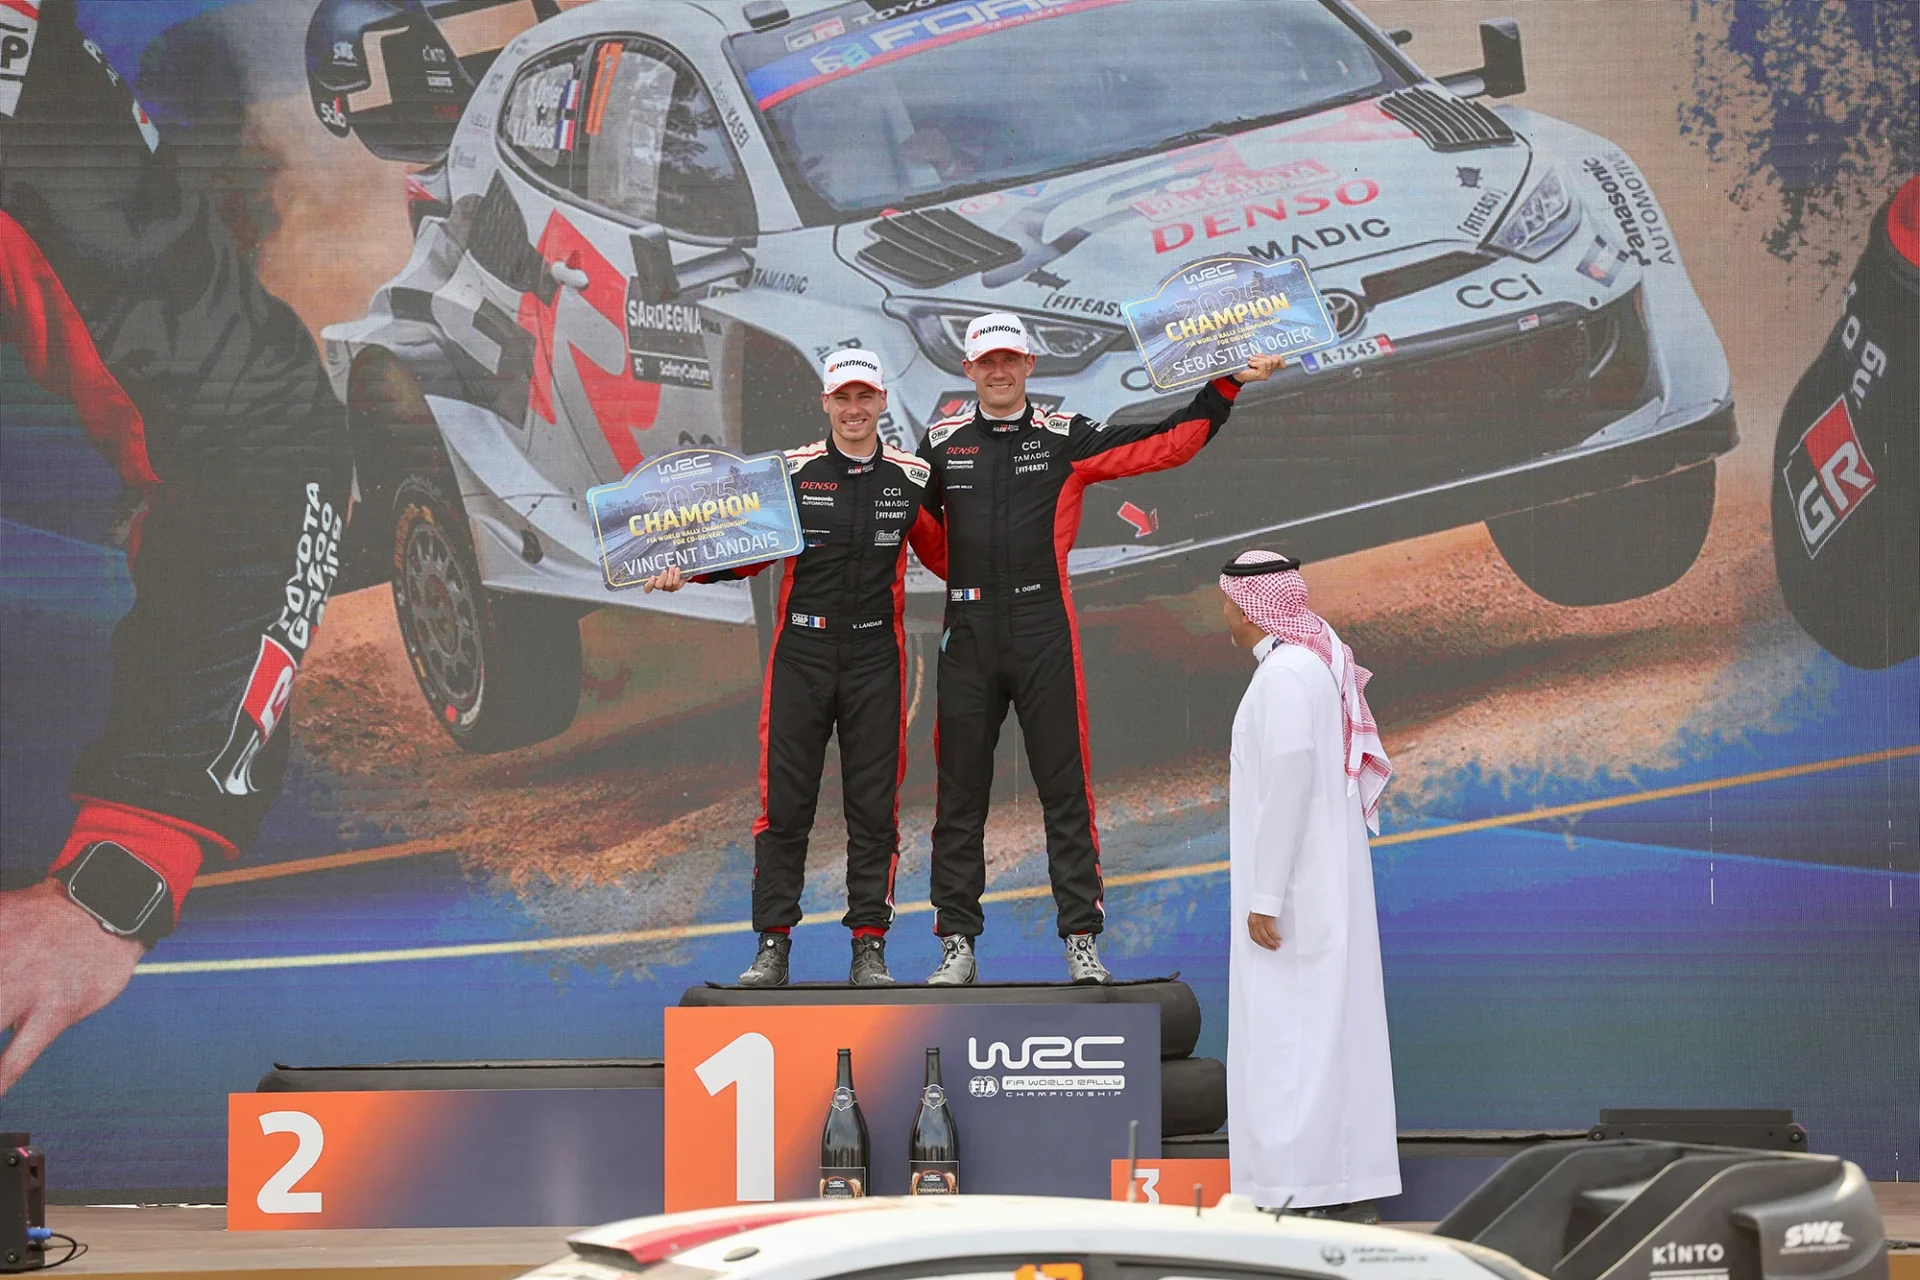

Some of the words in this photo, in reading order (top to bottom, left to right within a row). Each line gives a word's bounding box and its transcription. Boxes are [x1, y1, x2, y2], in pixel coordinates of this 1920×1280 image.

[1151, 178, 1380, 255] DENSO
[1583, 156, 1652, 267] Panasonic
[1247, 218, 1391, 263] MADIC
[754, 268, 809, 294] TAMADIC
[1183, 262, 1236, 285] WRC
[1175, 279, 1266, 323] 2025
[628, 301, 702, 333] SARDEGNA
[1165, 292, 1290, 341] CHAMPION
[979, 325, 1022, 336] Hankook
[1196, 333, 1218, 345] WORLD
[1219, 327, 1237, 341] RALLY
[1236, 317, 1282, 334] CHAMPIONSHIP
[1216, 338, 1230, 347] FOR
[1230, 331, 1256, 343] DRIVERS
[836, 359, 878, 372] Hankook
[1172, 341, 1262, 378] SÉBASTIEN
[1267, 326, 1316, 352] OGIER
[931, 430, 949, 440] OMP
[1049, 419, 1068, 429] OMP
[946, 446, 980, 455] DENSO
[1013, 450, 1050, 463] TAMADIC
[656, 454, 711, 475] WRC
[909, 469, 929, 481] OMP
[643, 475, 738, 518] 2025
[800, 481, 838, 491] DENSO
[1799, 440, 1872, 545] GR
[628, 491, 760, 537] CHAMPION
[646, 537, 658, 545] FIA
[658, 532, 680, 542] WORLD
[681, 527, 700, 537] RALLY
[701, 518, 749, 533] CHAMPIONSHIP
[672, 537, 686, 546] FOR
[686, 530, 725, 542] CO-DRIVERS
[269, 482, 321, 632] TOYOTA
[623, 545, 699, 577] VINCENT
[703, 530, 780, 561] LANDAIS
[288, 502, 333, 650] GAZOO
[1022, 583, 1041, 592] OGIER
[859, 619, 882, 629] LANDAIS
[968, 1036, 1125, 1070] WRC
[1005, 1078, 1024, 1086] FIA
[1028, 1078, 1074, 1086] WORLD
[1077, 1078, 1122, 1086] RALLY
[1005, 1090, 1122, 1098] CHAMPIONSHIP
[694, 1032, 775, 1202] 1
[256, 1111, 325, 1215] 2
